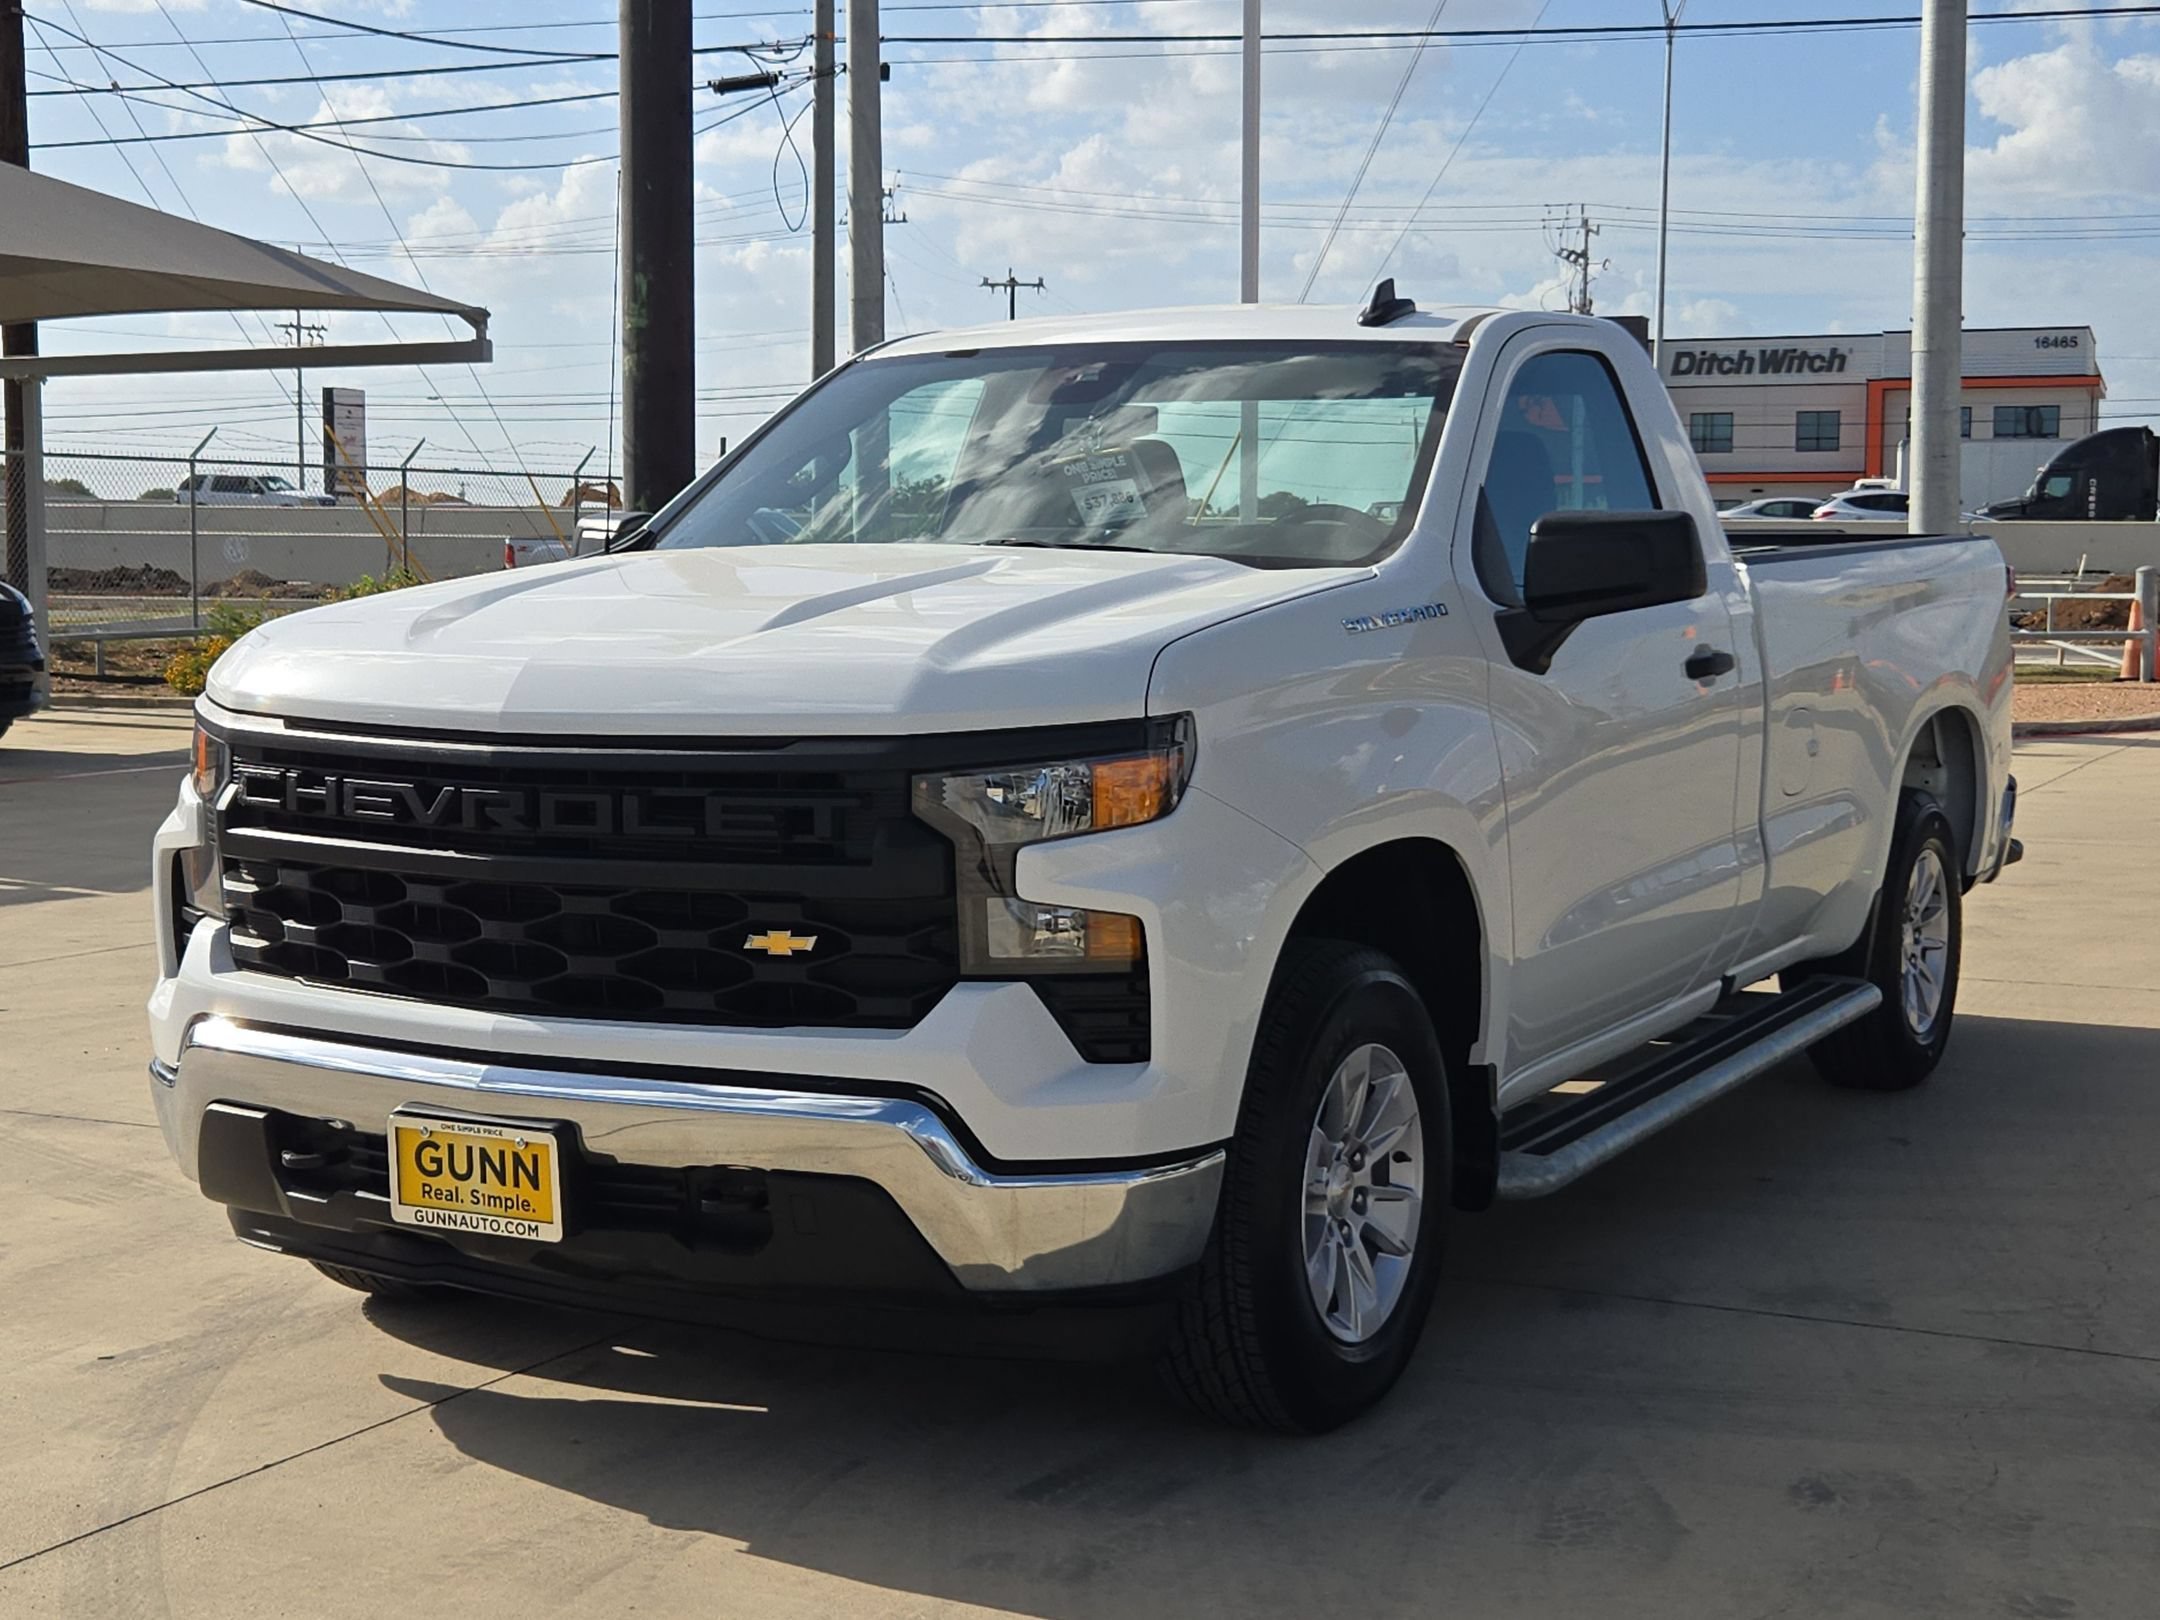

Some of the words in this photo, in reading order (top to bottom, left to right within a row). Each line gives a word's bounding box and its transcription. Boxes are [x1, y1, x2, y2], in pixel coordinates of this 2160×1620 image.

[2034, 336, 2078, 349] 16465
[1671, 350, 1754, 376] Ditch
[1758, 347, 1847, 374] Witch
[1064, 462, 1089, 476] ONE
[1342, 602, 1449, 634] SILVERADO
[236, 764, 862, 840] CHEVROLET
[440, 1123, 456, 1132] ONE
[457, 1125, 481, 1134] SIMPLE
[482, 1127, 504, 1137] PRICE
[414, 1140, 540, 1191] GUNN
[421, 1183, 464, 1204] Real.
[414, 1209, 540, 1238] GUNNAUTO.COM
